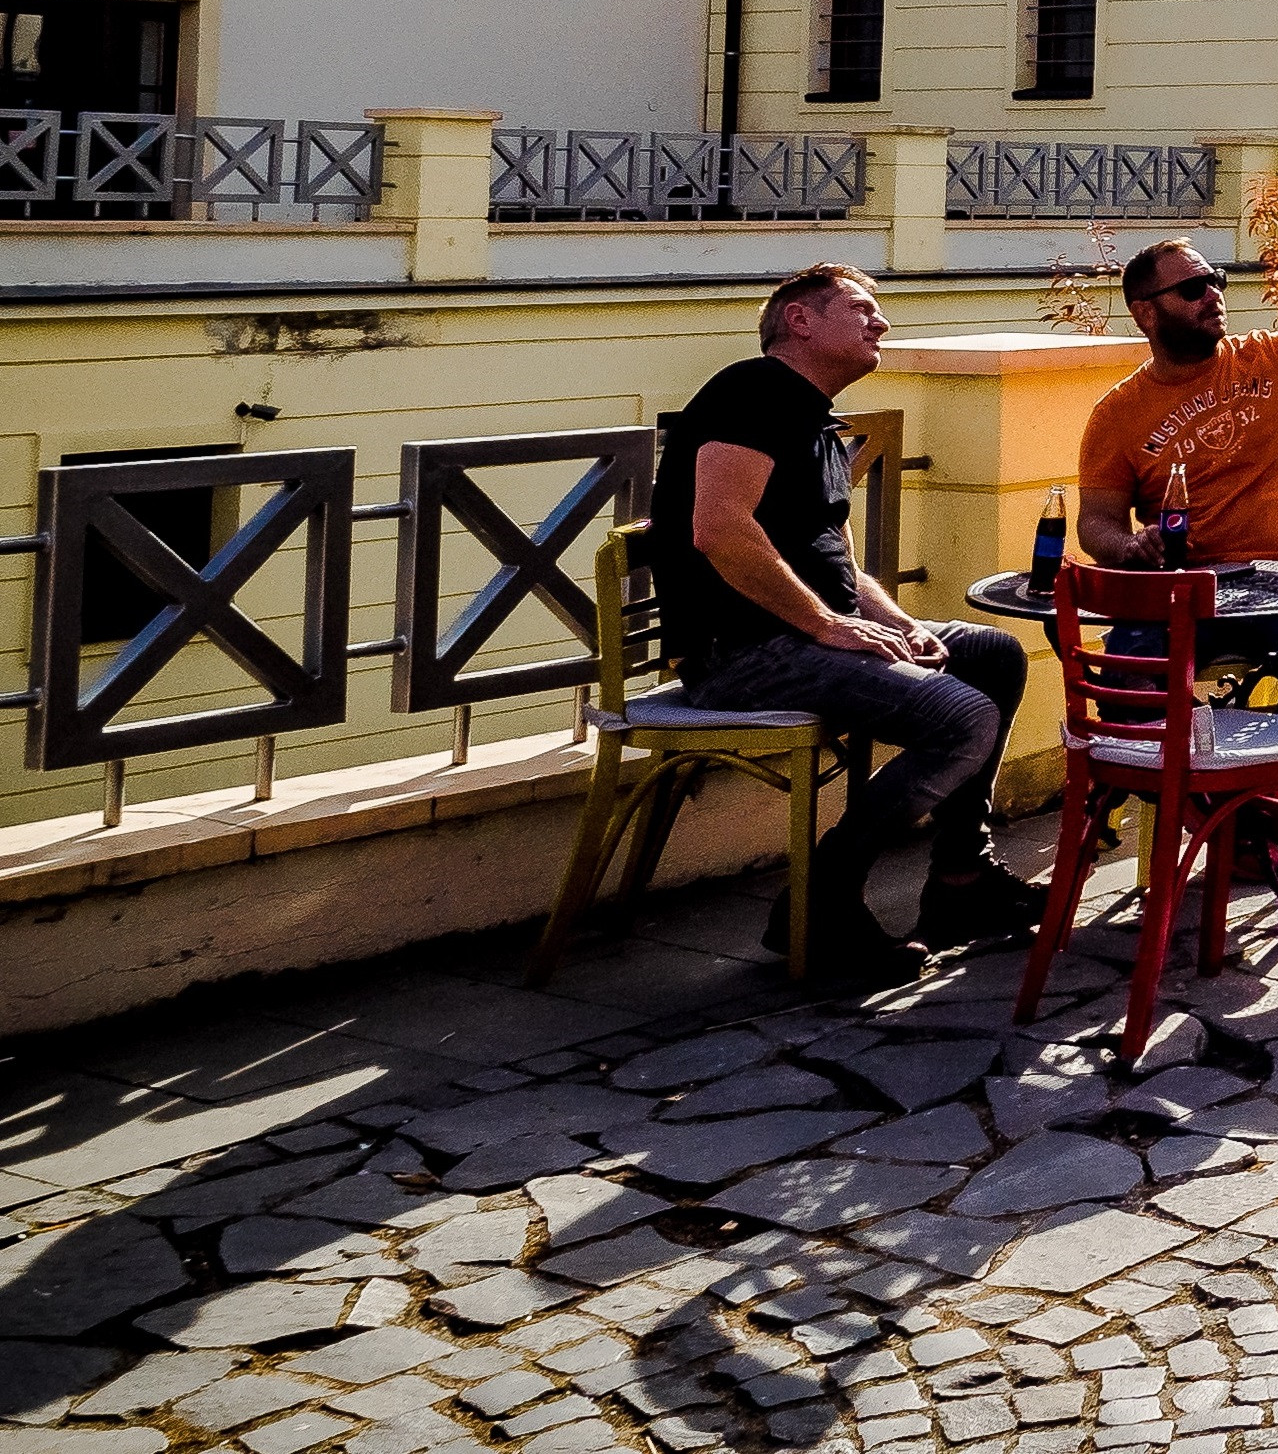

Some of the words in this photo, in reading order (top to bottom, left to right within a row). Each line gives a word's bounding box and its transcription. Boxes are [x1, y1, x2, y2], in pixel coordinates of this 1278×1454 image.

[1141, 386, 1218, 458] MUSTANG
[1221, 376, 1274, 405] JEANS
[1174, 437, 1196, 459] 19
[1235, 405, 1261, 427] 32
